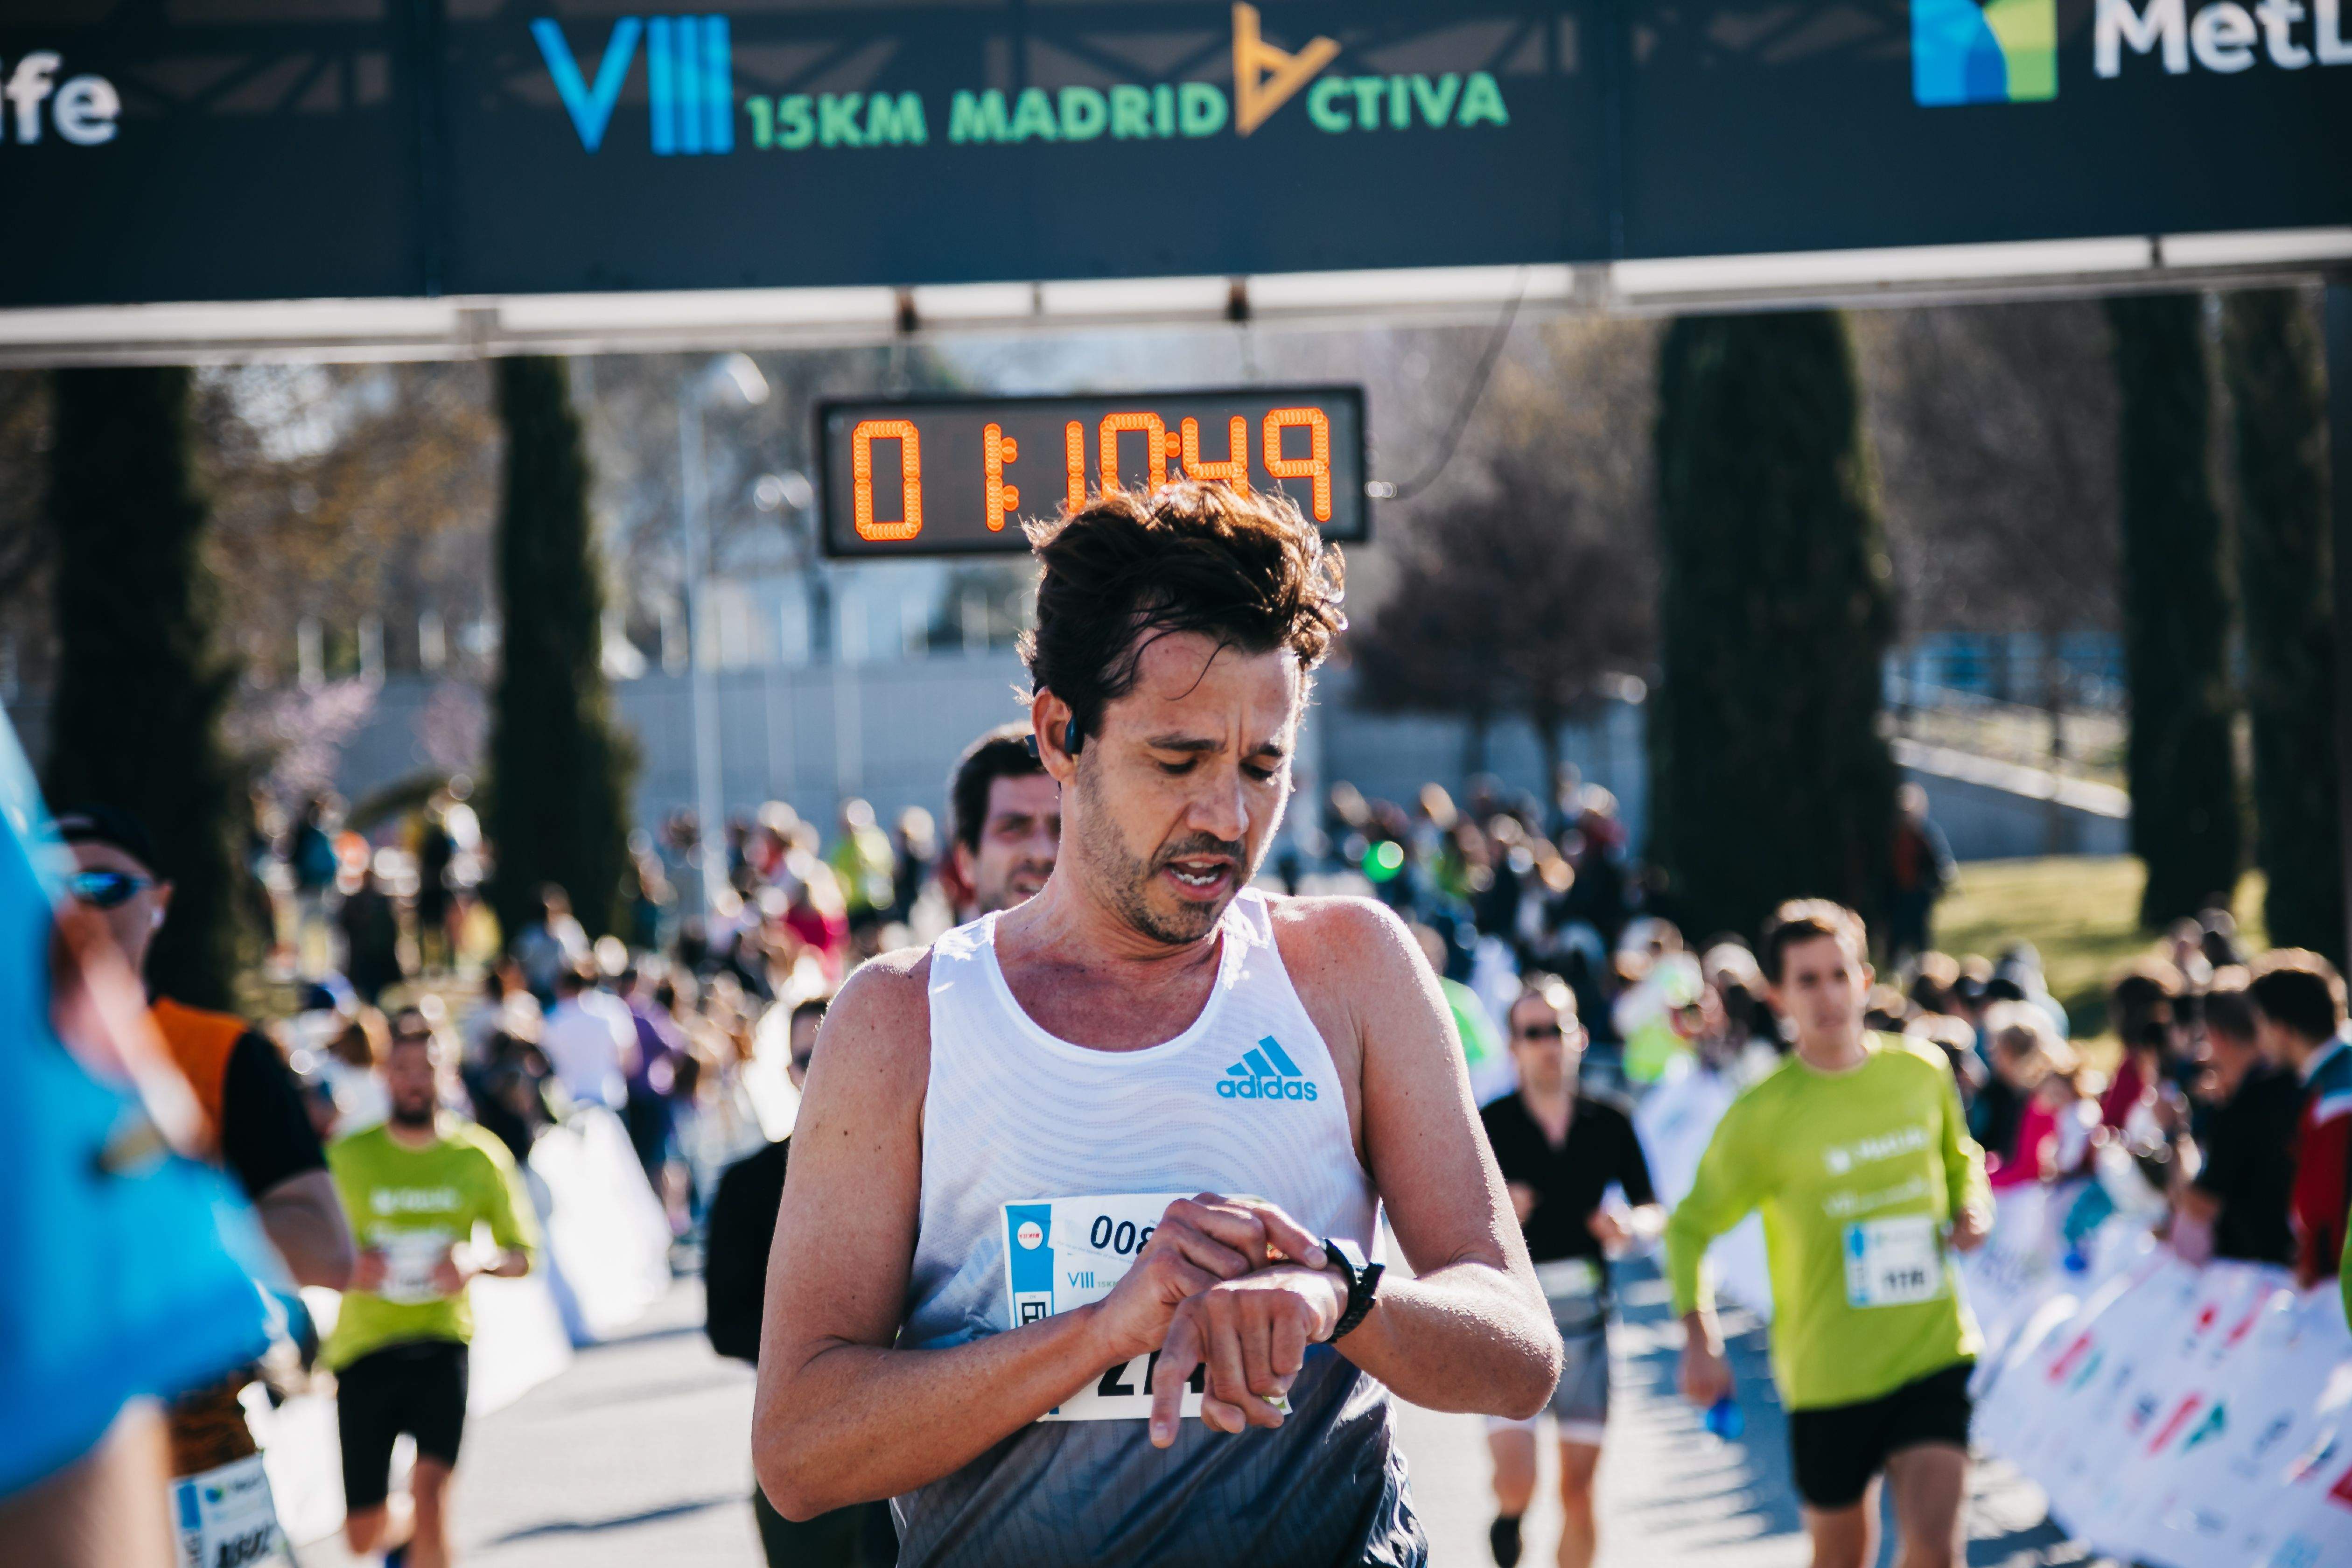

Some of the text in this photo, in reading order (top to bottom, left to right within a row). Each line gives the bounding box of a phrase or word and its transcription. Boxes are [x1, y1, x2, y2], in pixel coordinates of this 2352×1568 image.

[529, 14, 735, 156] VIII
[746, 91, 928, 150] 15KM
[949, 82, 1228, 143] MADRID
[1216, 1075, 1318, 1101] adidas
[1067, 1271, 1094, 1288] VIII
